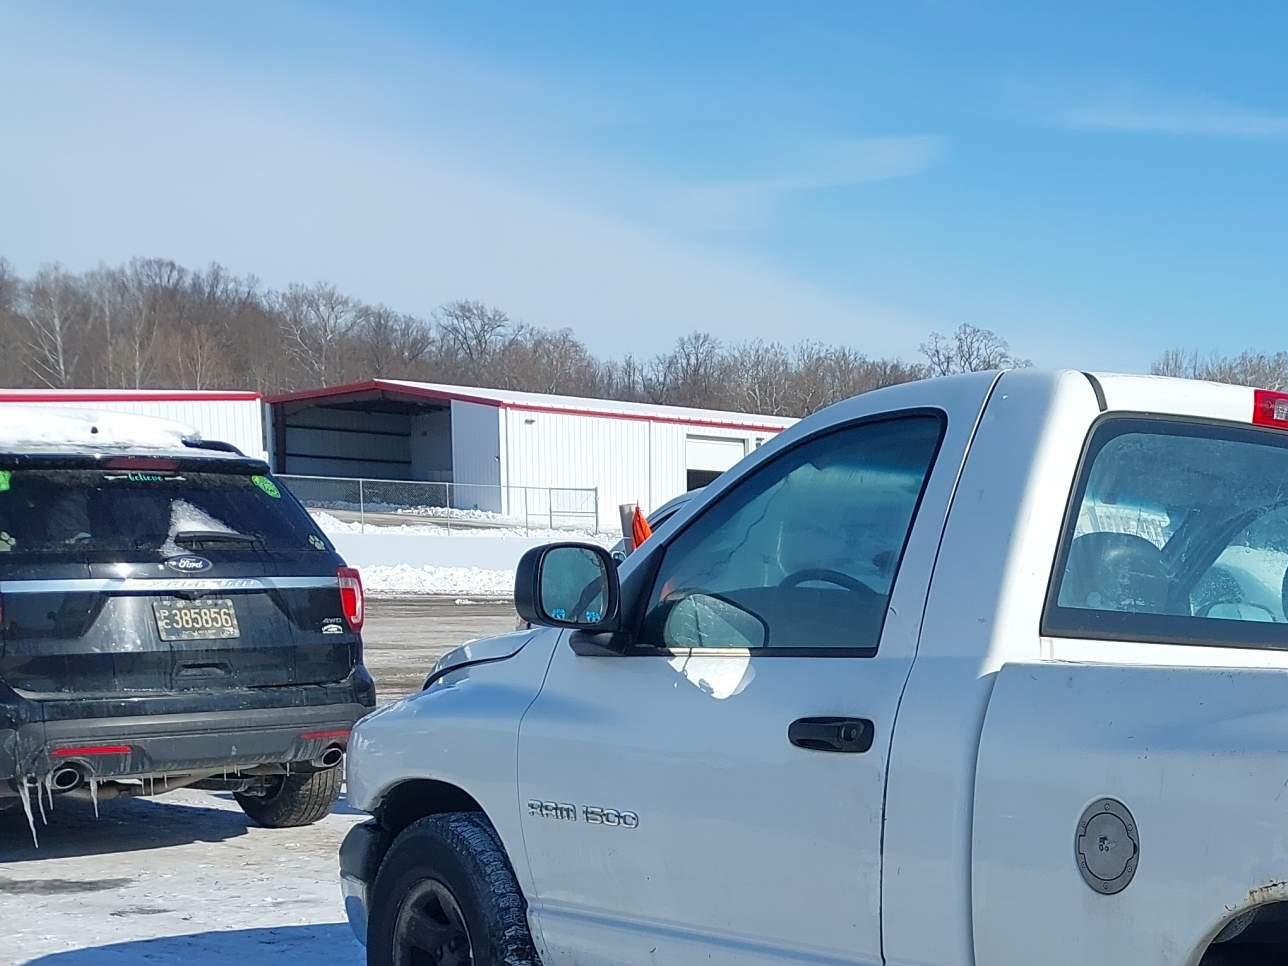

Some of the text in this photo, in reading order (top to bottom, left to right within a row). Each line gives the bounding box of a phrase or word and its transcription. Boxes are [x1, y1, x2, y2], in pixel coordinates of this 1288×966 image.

[128, 472, 163, 482] believe
[178, 558, 203, 569] Ford
[171, 608, 232, 628] 385856
[527, 799, 639, 829] RAM 1500
